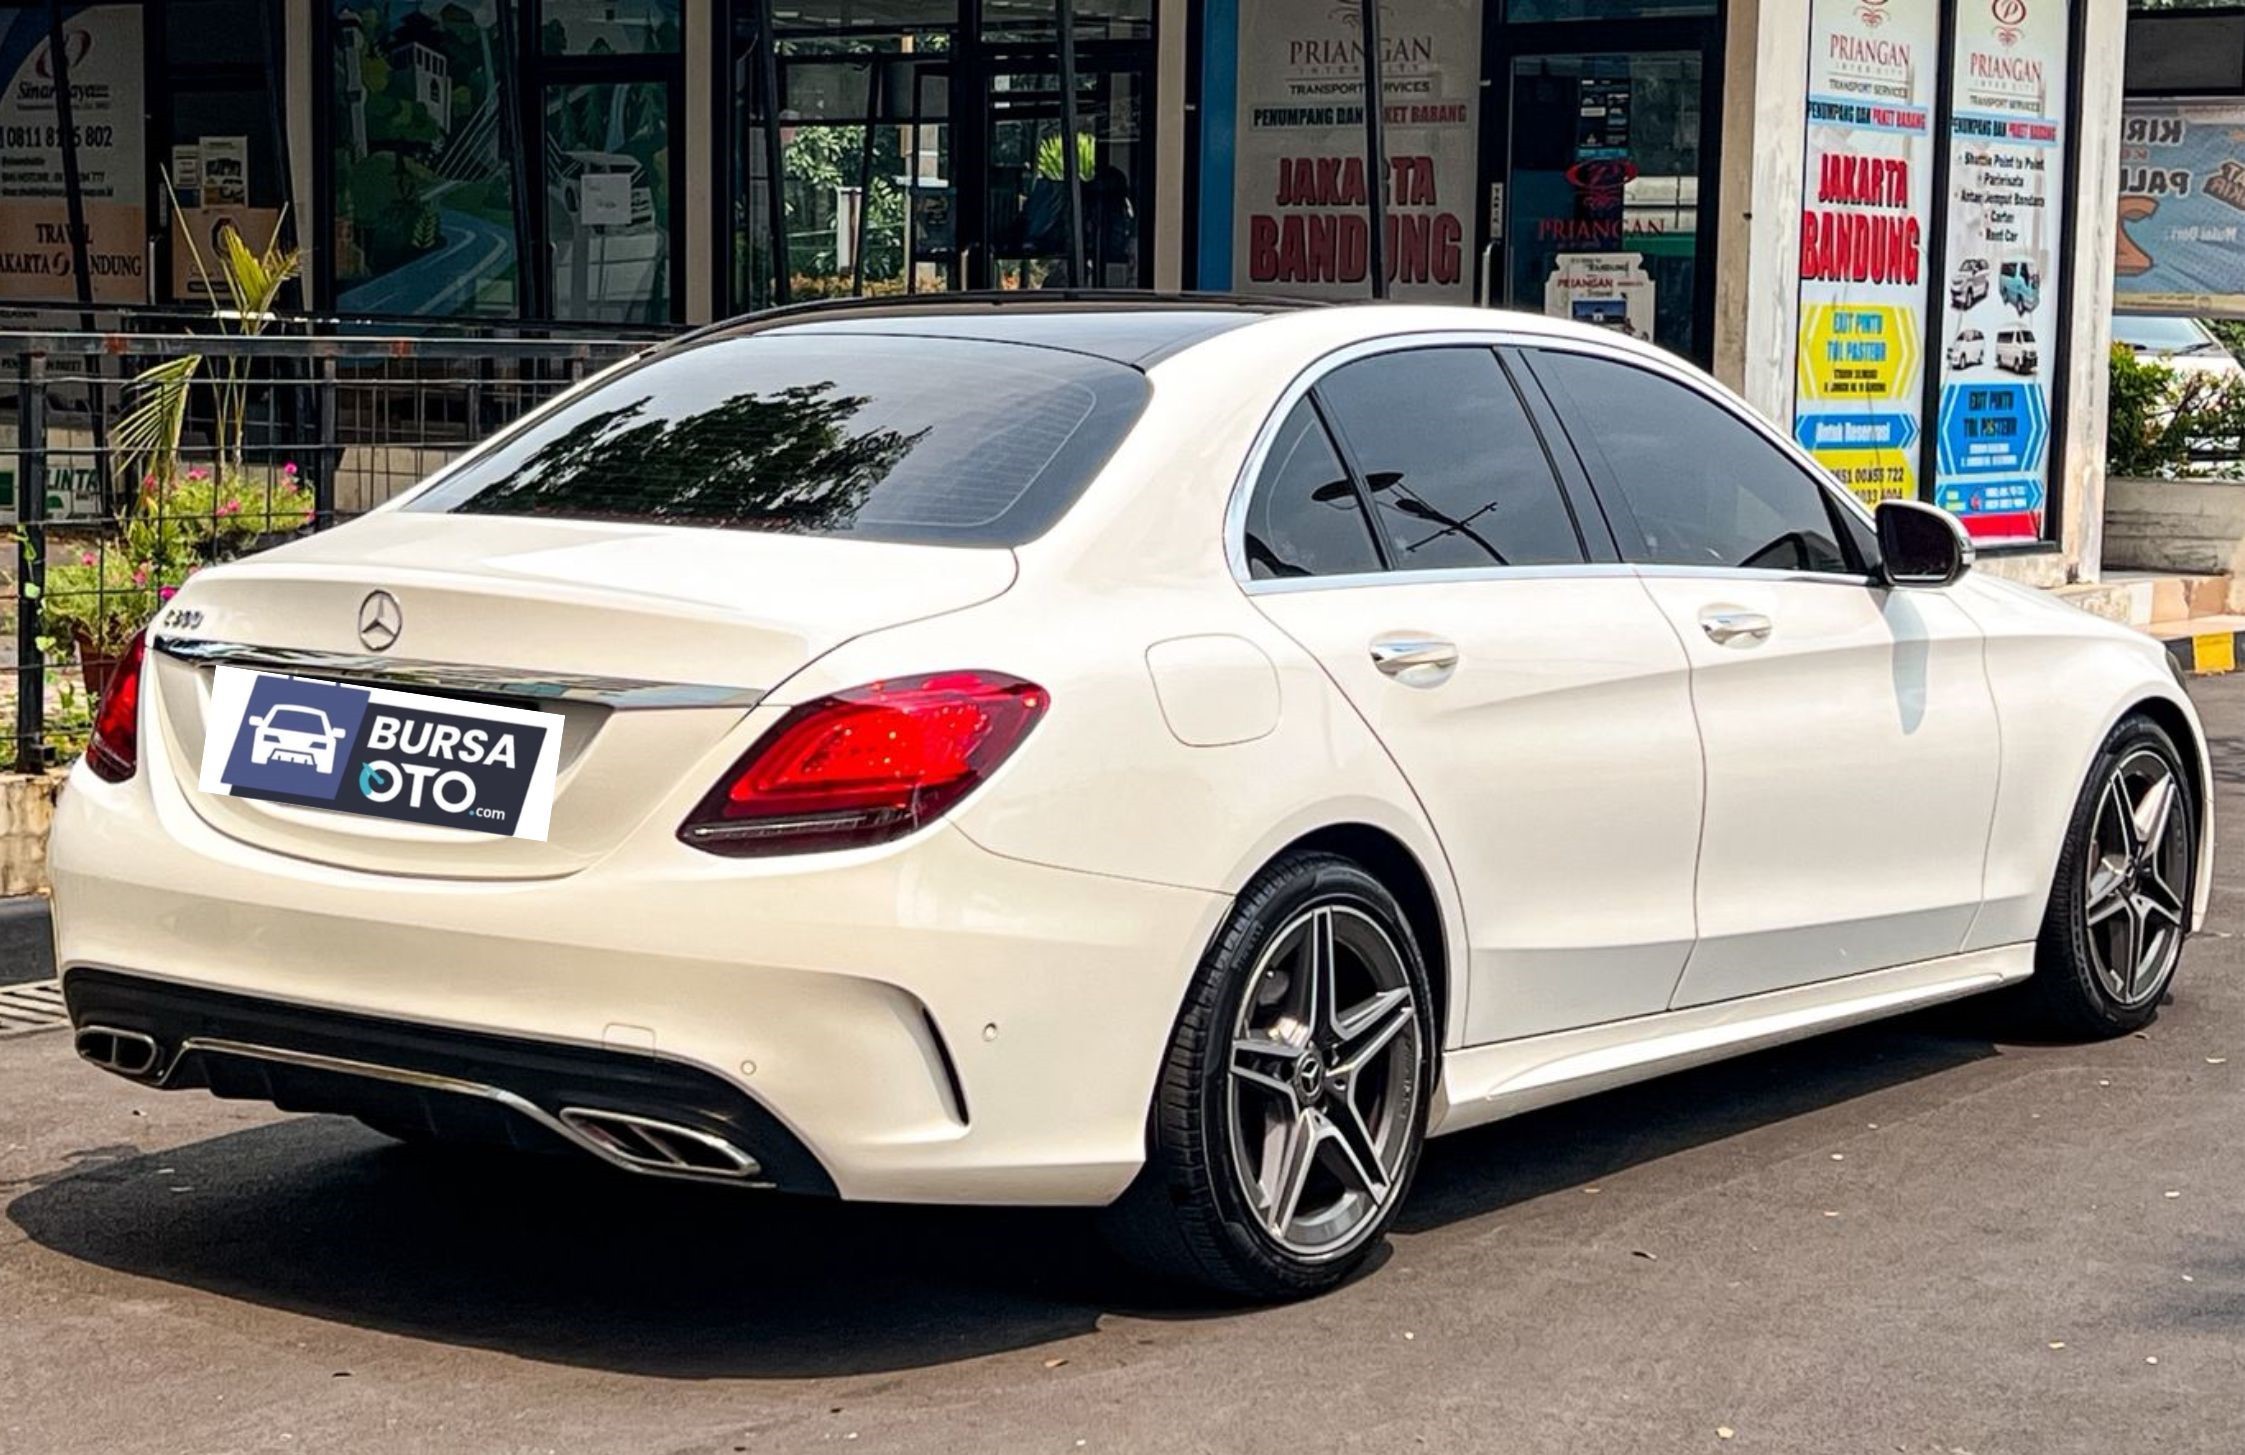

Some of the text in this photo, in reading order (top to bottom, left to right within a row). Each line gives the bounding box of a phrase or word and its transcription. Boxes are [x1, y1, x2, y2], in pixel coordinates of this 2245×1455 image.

[1829, 33, 1910, 67] PRIANGAN
[1970, 52, 2043, 82] PRIANGAN
[1290, 81, 1431, 95] TRANSPORT RVICES
[1254, 105, 1467, 126] PENUMPANG DAN KET BARANG
[7, 126, 41, 148] 0811
[85, 126, 113, 147] 802
[1276, 156, 1437, 206] JAKATA
[1818, 152, 1909, 209] JAKARTA
[35, 223, 93, 244] TRAVL
[1538, 215, 1665, 242] PRIANGAN
[1800, 210, 1921, 286] BANDUNG
[0, 253, 142, 276] AKARTA NDUNG
